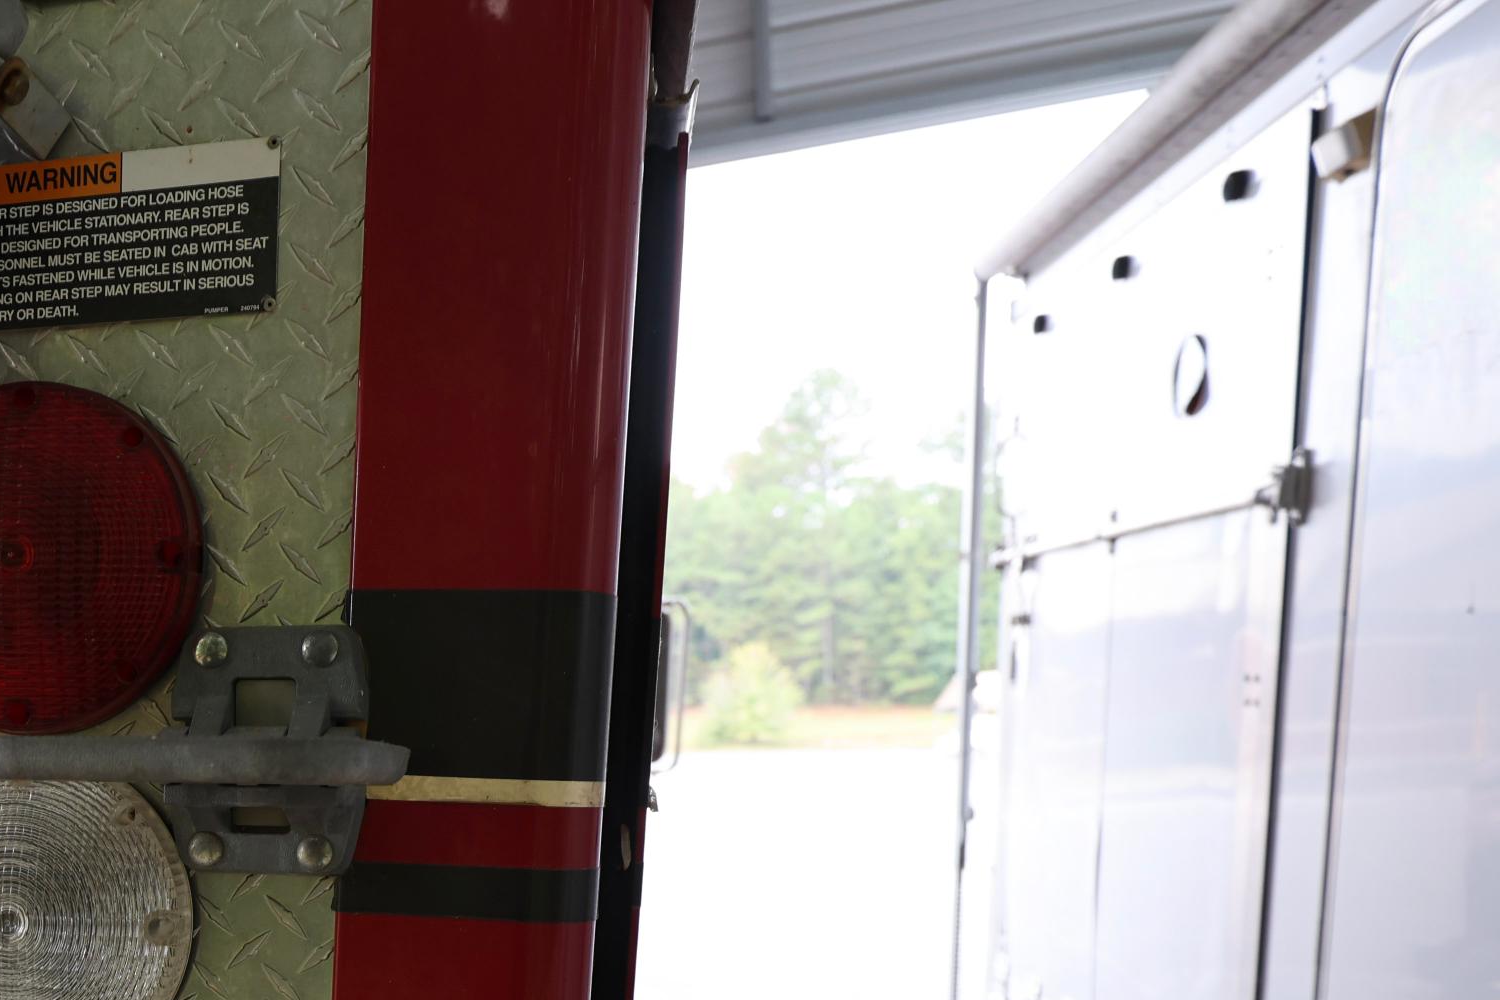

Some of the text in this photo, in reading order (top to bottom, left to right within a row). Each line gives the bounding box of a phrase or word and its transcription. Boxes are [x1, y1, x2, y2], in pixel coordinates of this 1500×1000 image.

[5, 161, 117, 194] WARNING
[9, 205, 40, 219] STEP
[42, 204, 53, 216] IS
[55, 197, 118, 214] DESIGNED
[121, 195, 146, 208] FOR
[149, 189, 205, 205] LOADING
[208, 185, 244, 200] HOSE
[6, 223, 29, 236] THE
[32, 218, 82, 233] VEHICLE
[84, 211, 162, 229] STATIONARY.
[164, 208, 199, 221] REAR
[202, 204, 235, 218] STEP
[237, 202, 250, 214] IS
[1, 238, 61, 254] DESIGNED
[64, 235, 89, 248] FOR
[91, 226, 188, 246] TRANSPORTING
[191, 221, 244, 237] PEOPLE.
[47, 253, 82, 267] MUST
[84, 251, 101, 264] BE
[103, 246, 151, 262] SEATED
[154, 246, 166, 258] IN
[171, 243, 198, 256] CAB
[201, 240, 233, 254] WITH
[235, 236, 269, 251] SEAT
[13, 271, 74, 287] FASTENED
[77, 267, 116, 281] WHILE
[118, 262, 170, 278] VEHICLE
[172, 261, 184, 274] IS
[186, 260, 199, 273] IN
[201, 256, 254, 271] MOTION.
[15, 291, 33, 303] ON
[35, 289, 69, 302] REAR
[71, 286, 103, 299] STEP
[104, 283, 131, 297] MAY
[133, 280, 182, 295] RESULT
[183, 278, 196, 291] IN
[198, 273, 254, 290] SERIOUS
[16, 308, 35, 321] OR
[37, 305, 79, 319] DEATH.
[204, 306, 229, 314] PUMPER
